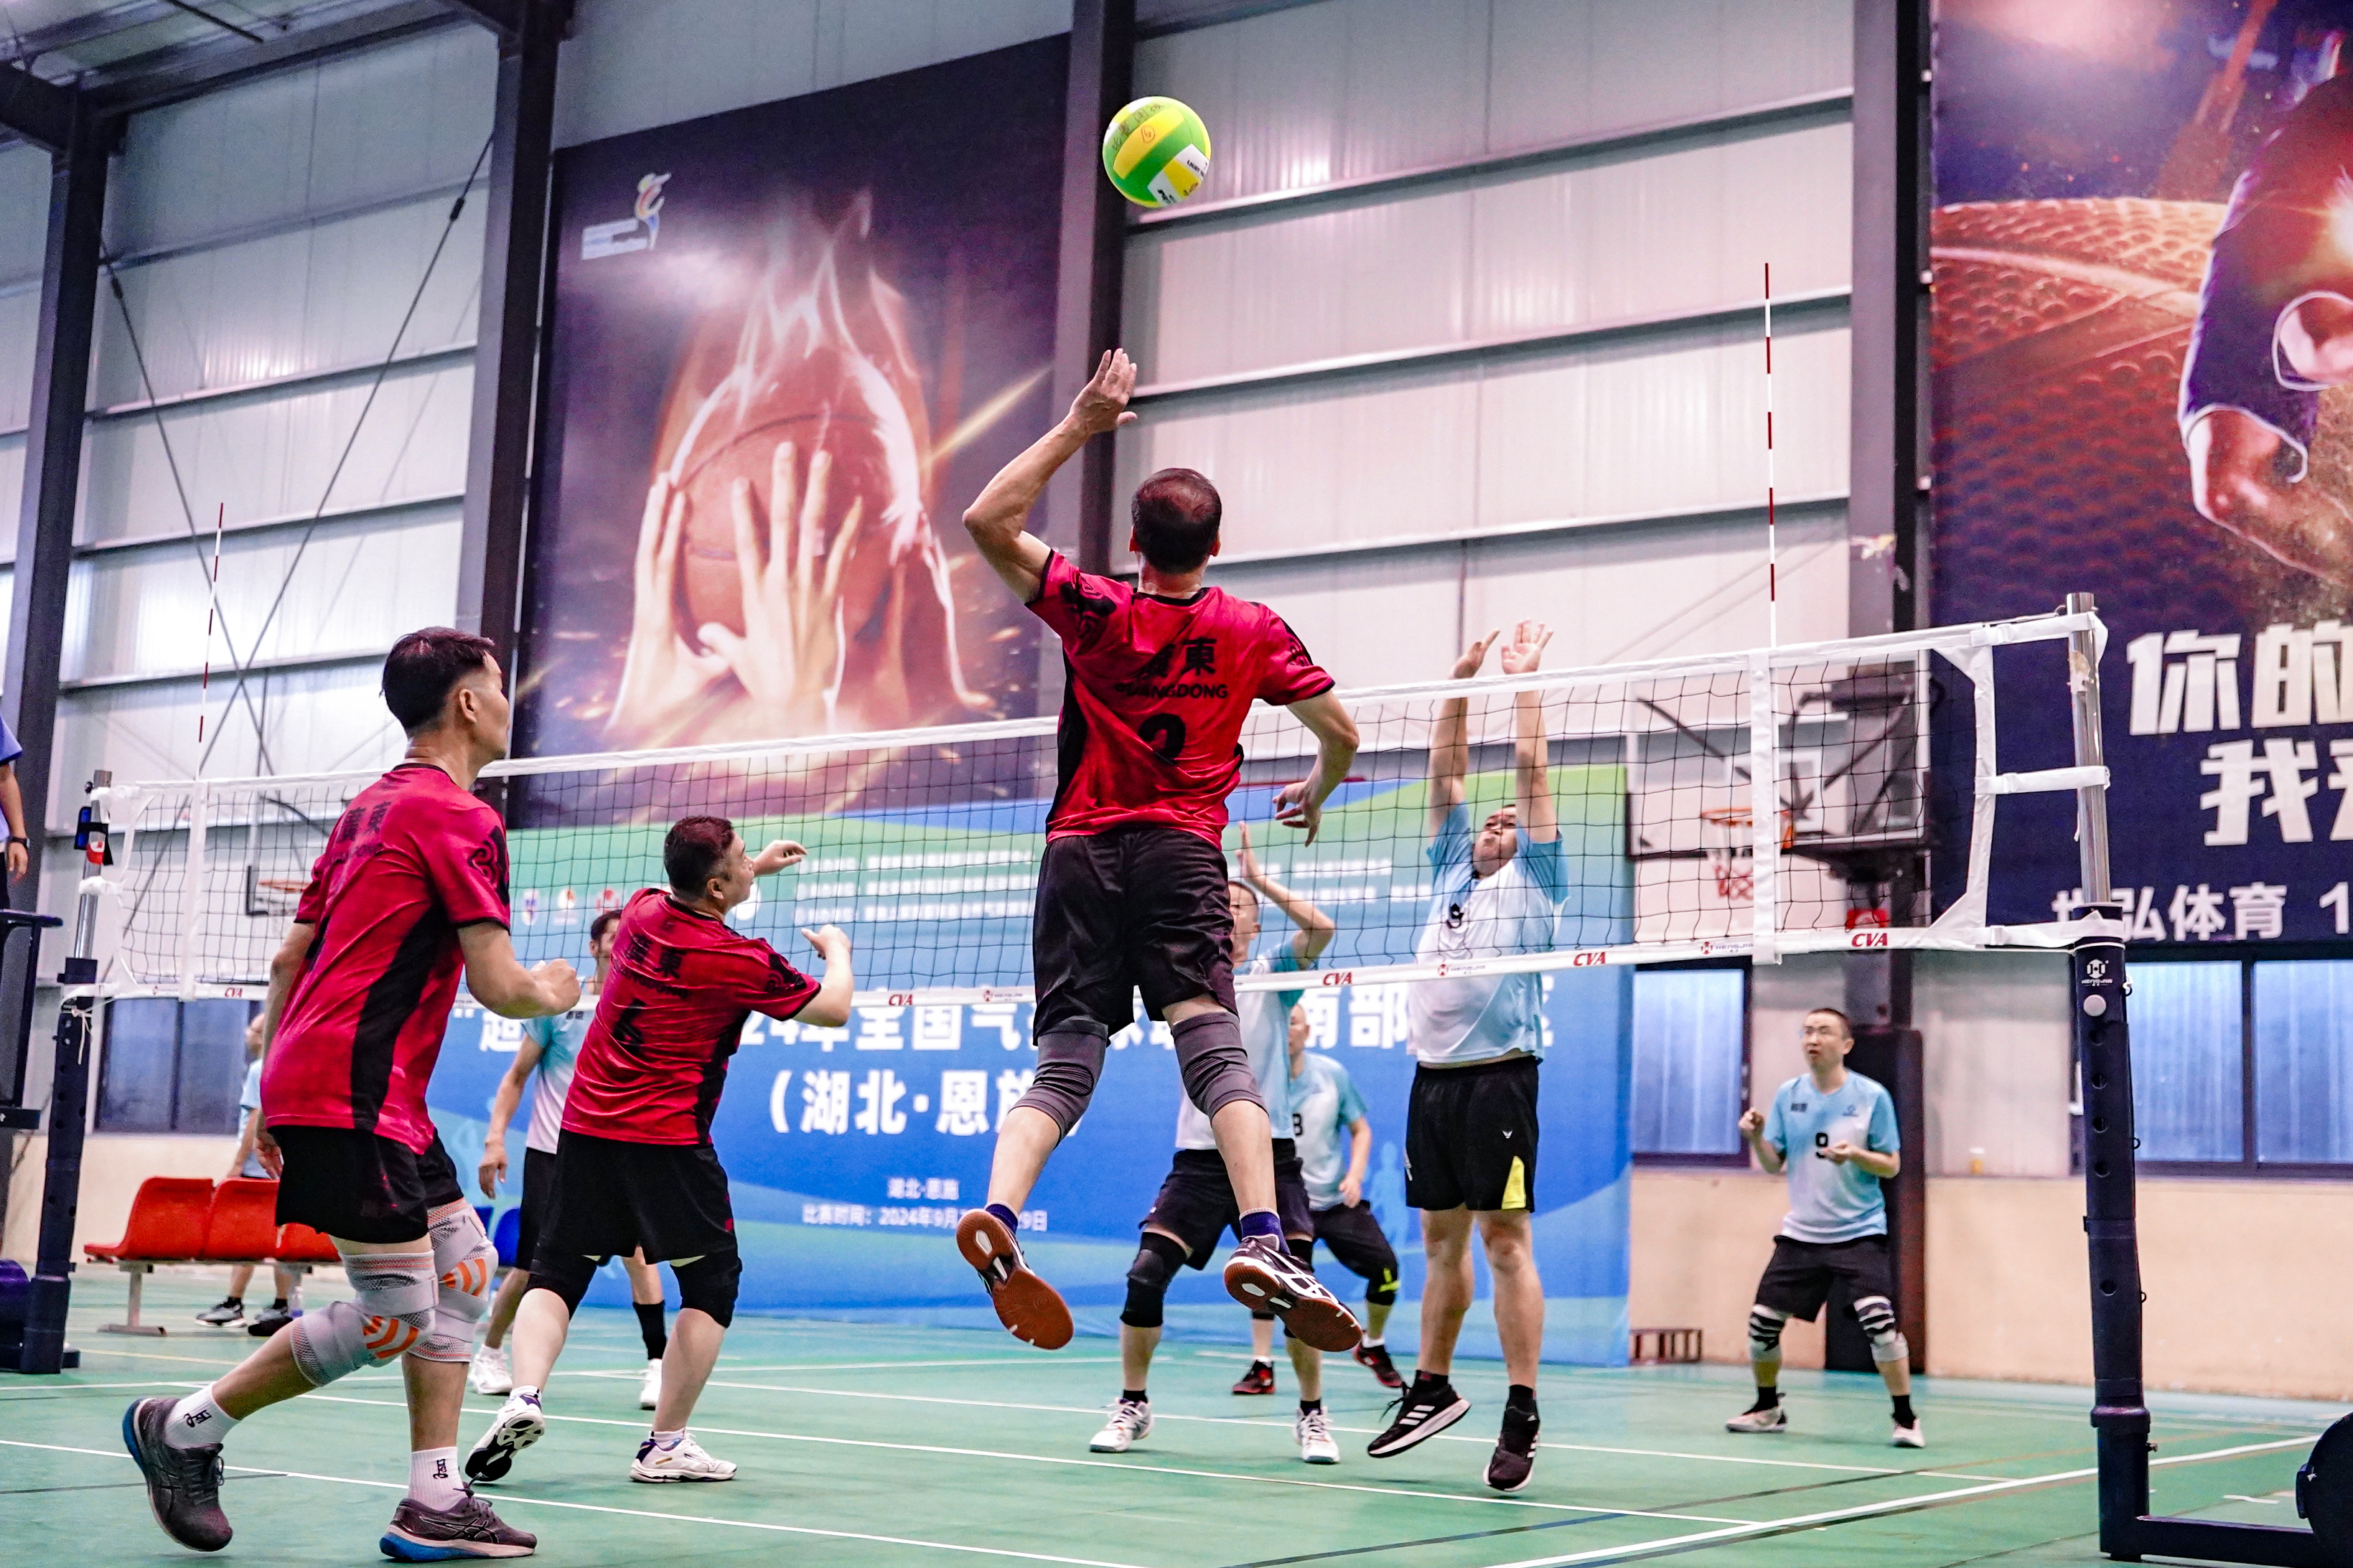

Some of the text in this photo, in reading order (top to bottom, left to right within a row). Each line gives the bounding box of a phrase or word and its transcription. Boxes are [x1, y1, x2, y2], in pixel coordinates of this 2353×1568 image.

[2126, 619, 2353, 736] 你的
[1851, 933, 1889, 947] CVA
[1573, 952, 1606, 967] CVA
[1323, 972, 1353, 986] CVA
[225, 987, 243, 998] CVA
[889, 994, 914, 1006] CVA
[1815, 1132, 1828, 1159] 9
